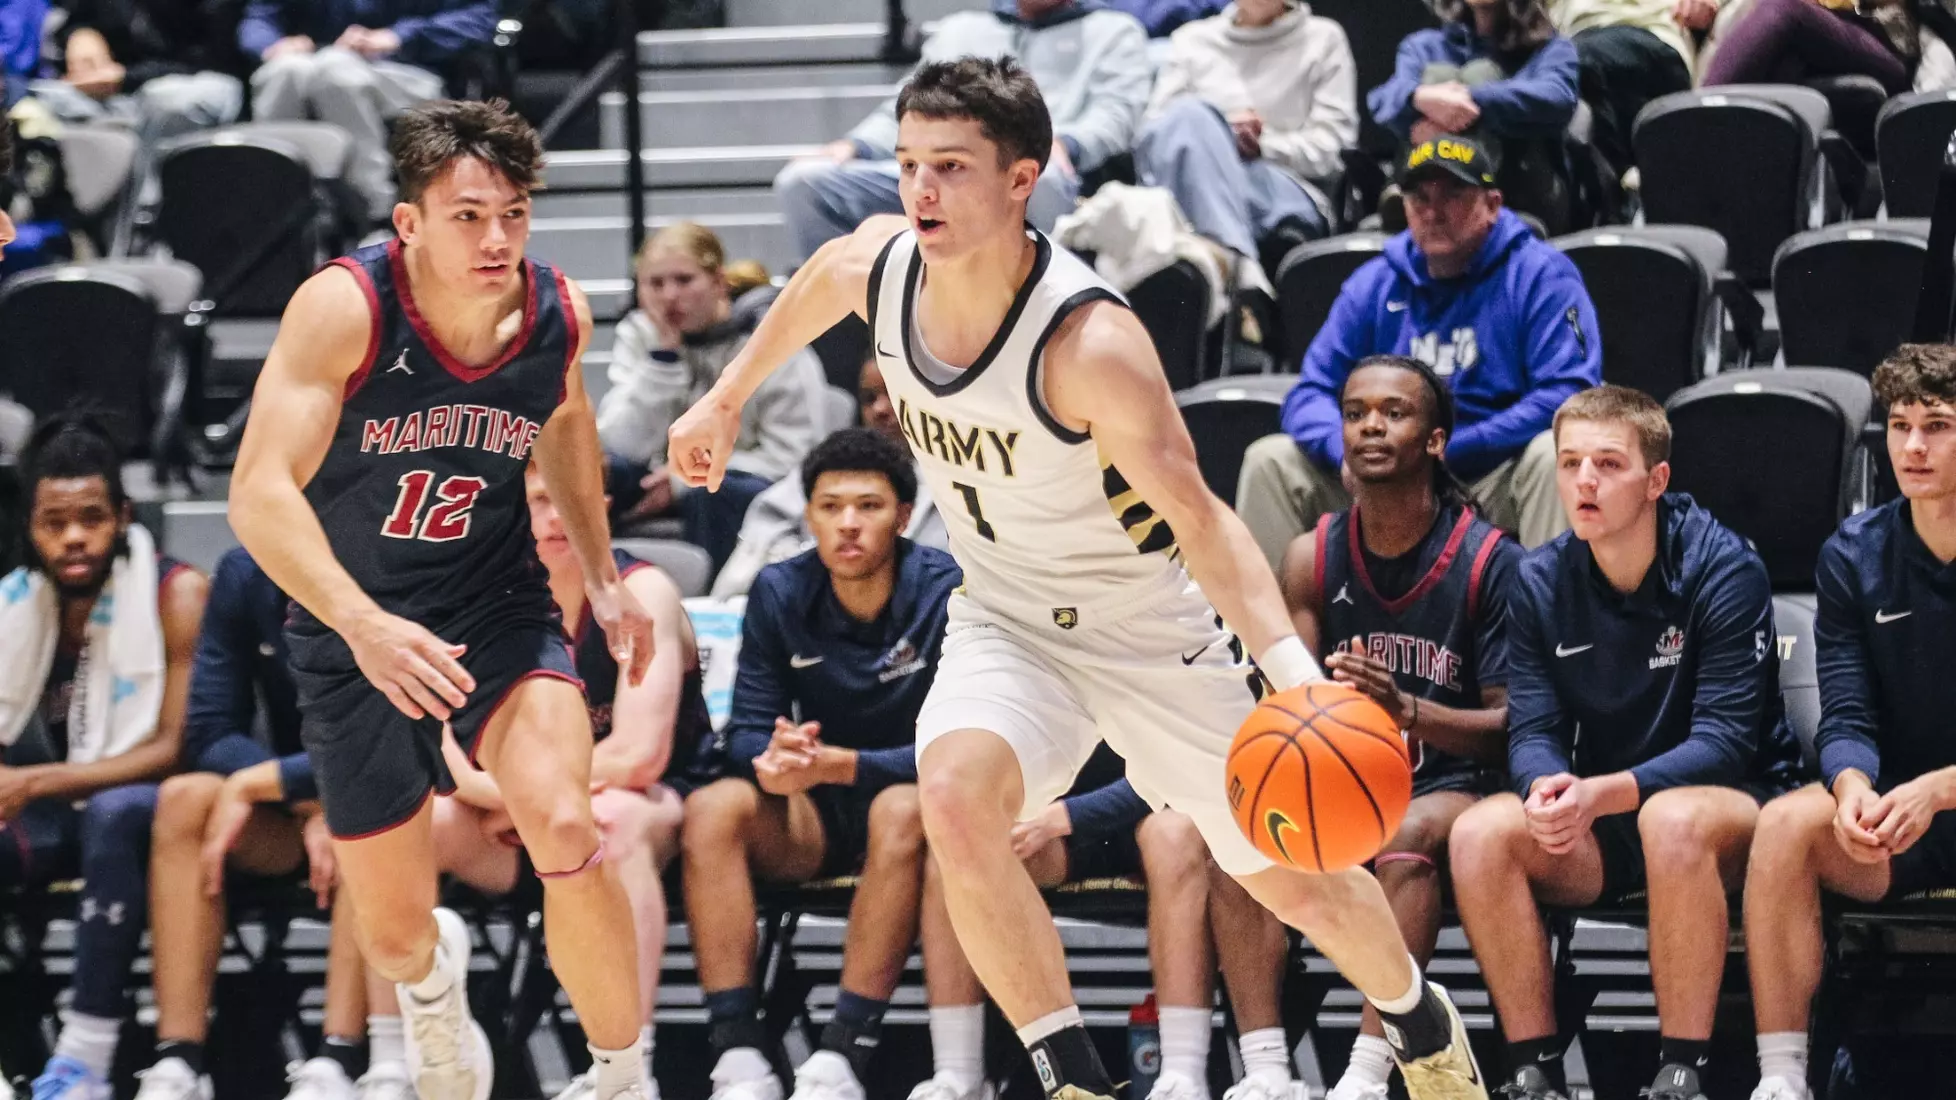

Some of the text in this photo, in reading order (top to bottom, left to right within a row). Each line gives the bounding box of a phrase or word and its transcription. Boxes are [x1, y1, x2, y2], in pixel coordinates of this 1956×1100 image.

[1437, 139, 1475, 164] CAV
[360, 403, 541, 460] MARITIME
[898, 395, 1022, 478] ARMY
[379, 469, 488, 542] 12
[951, 480, 997, 544] 1
[1335, 631, 1463, 692] RITIME
